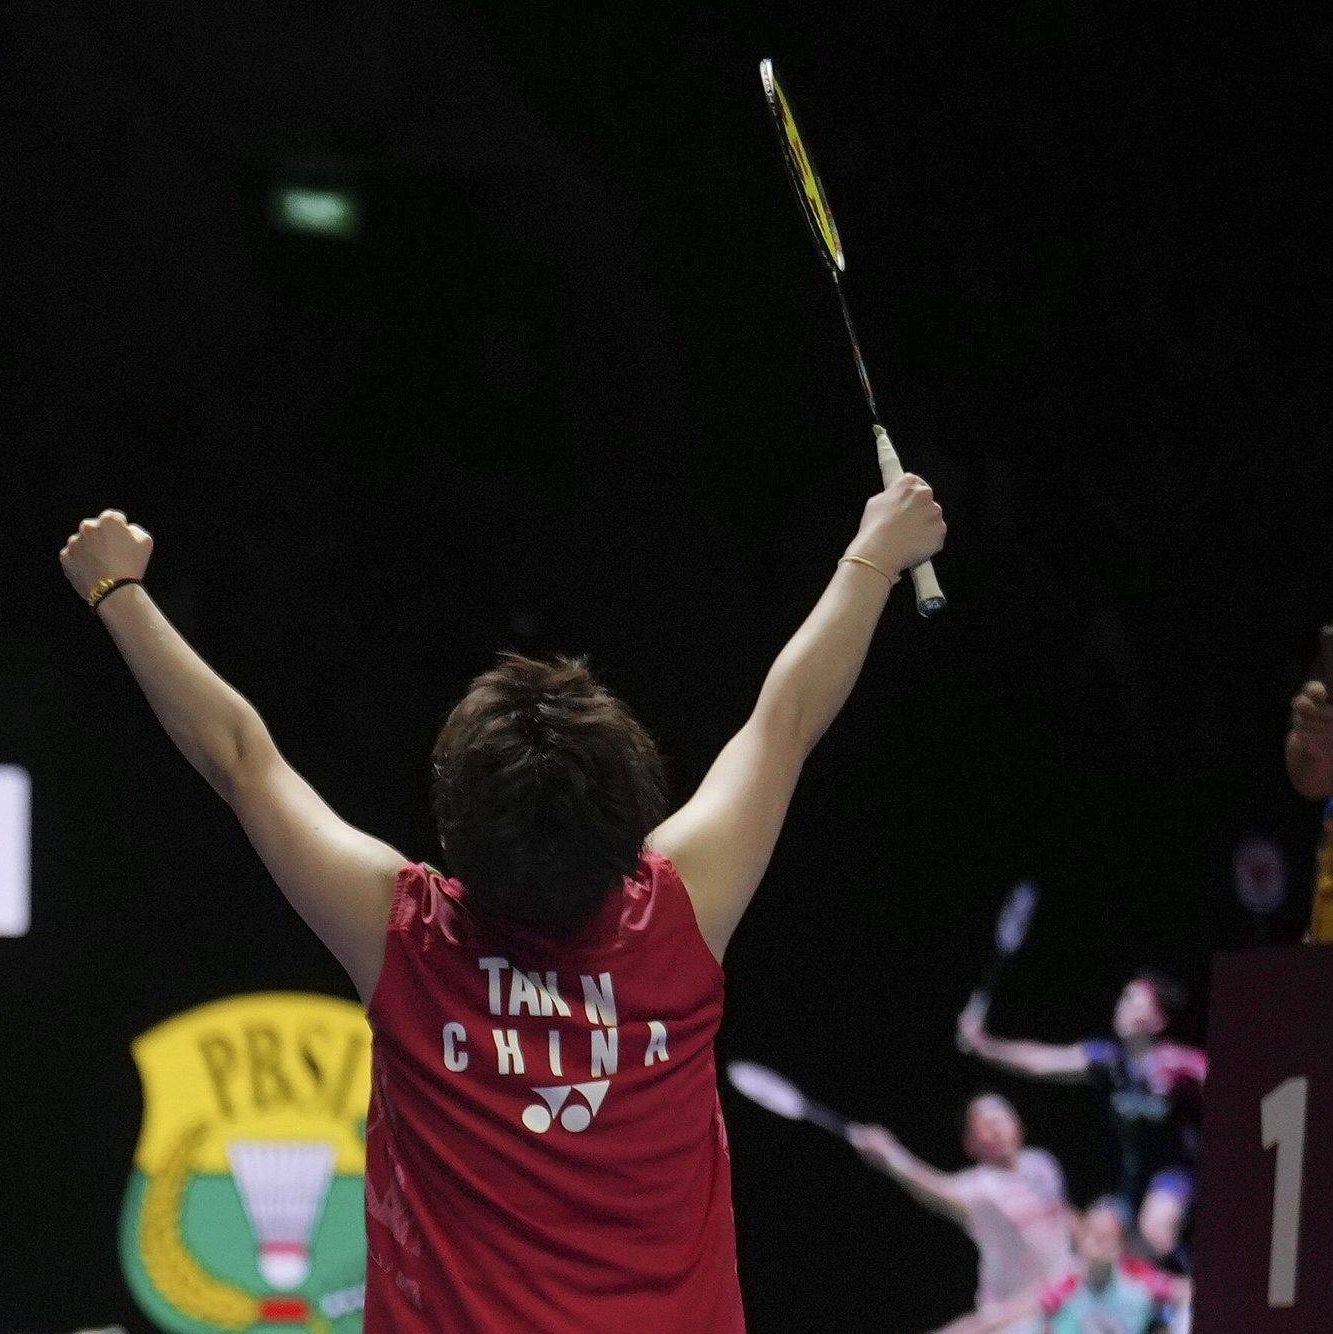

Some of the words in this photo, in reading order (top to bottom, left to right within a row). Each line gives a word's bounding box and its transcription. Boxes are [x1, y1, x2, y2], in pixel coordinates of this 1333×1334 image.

[580, 972, 618, 1028] N
[197, 1017, 366, 1118] PBSI
[442, 1020, 670, 1079] CHINA
[1260, 1075, 1309, 1309] 1
